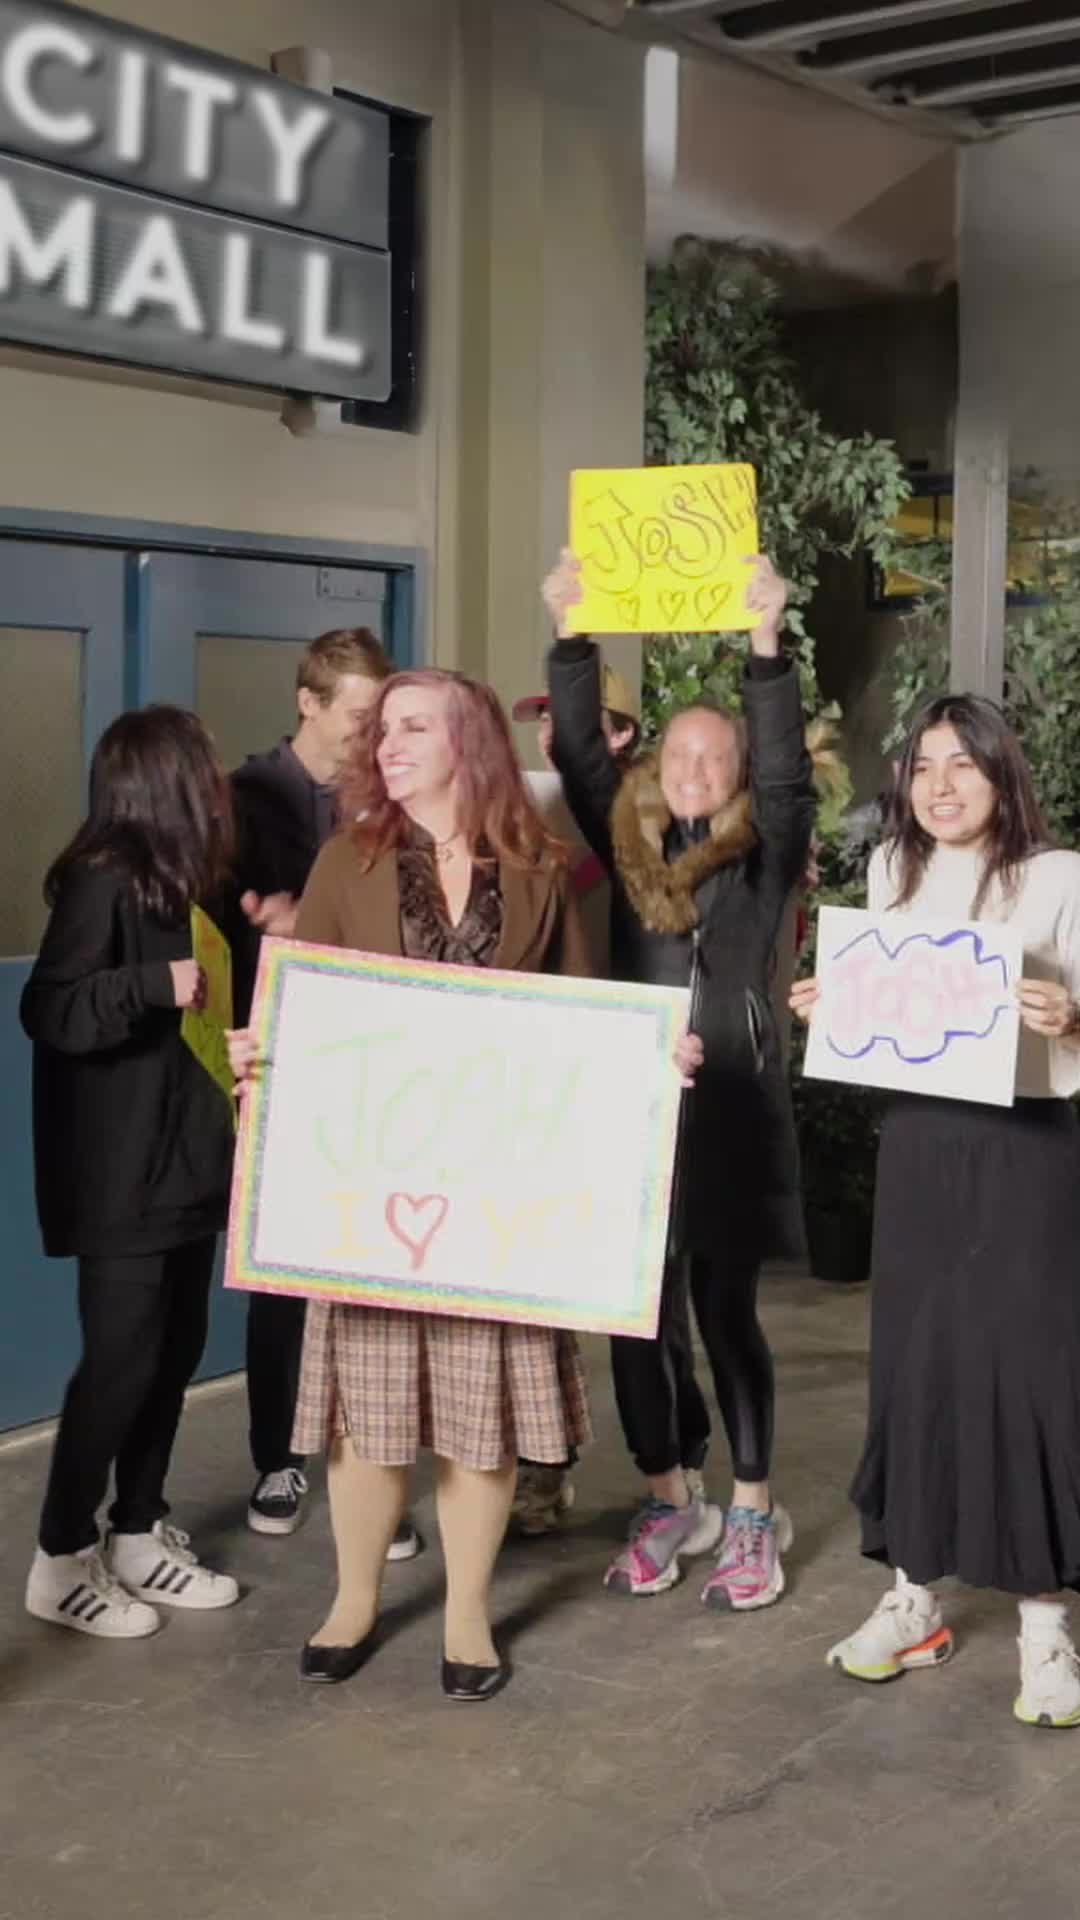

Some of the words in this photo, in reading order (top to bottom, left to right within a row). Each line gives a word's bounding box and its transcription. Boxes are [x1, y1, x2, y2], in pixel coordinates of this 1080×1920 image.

[2, 23, 332, 206] CITY
[0, 176, 364, 366] MALL
[320, 1190, 383, 1256] I
